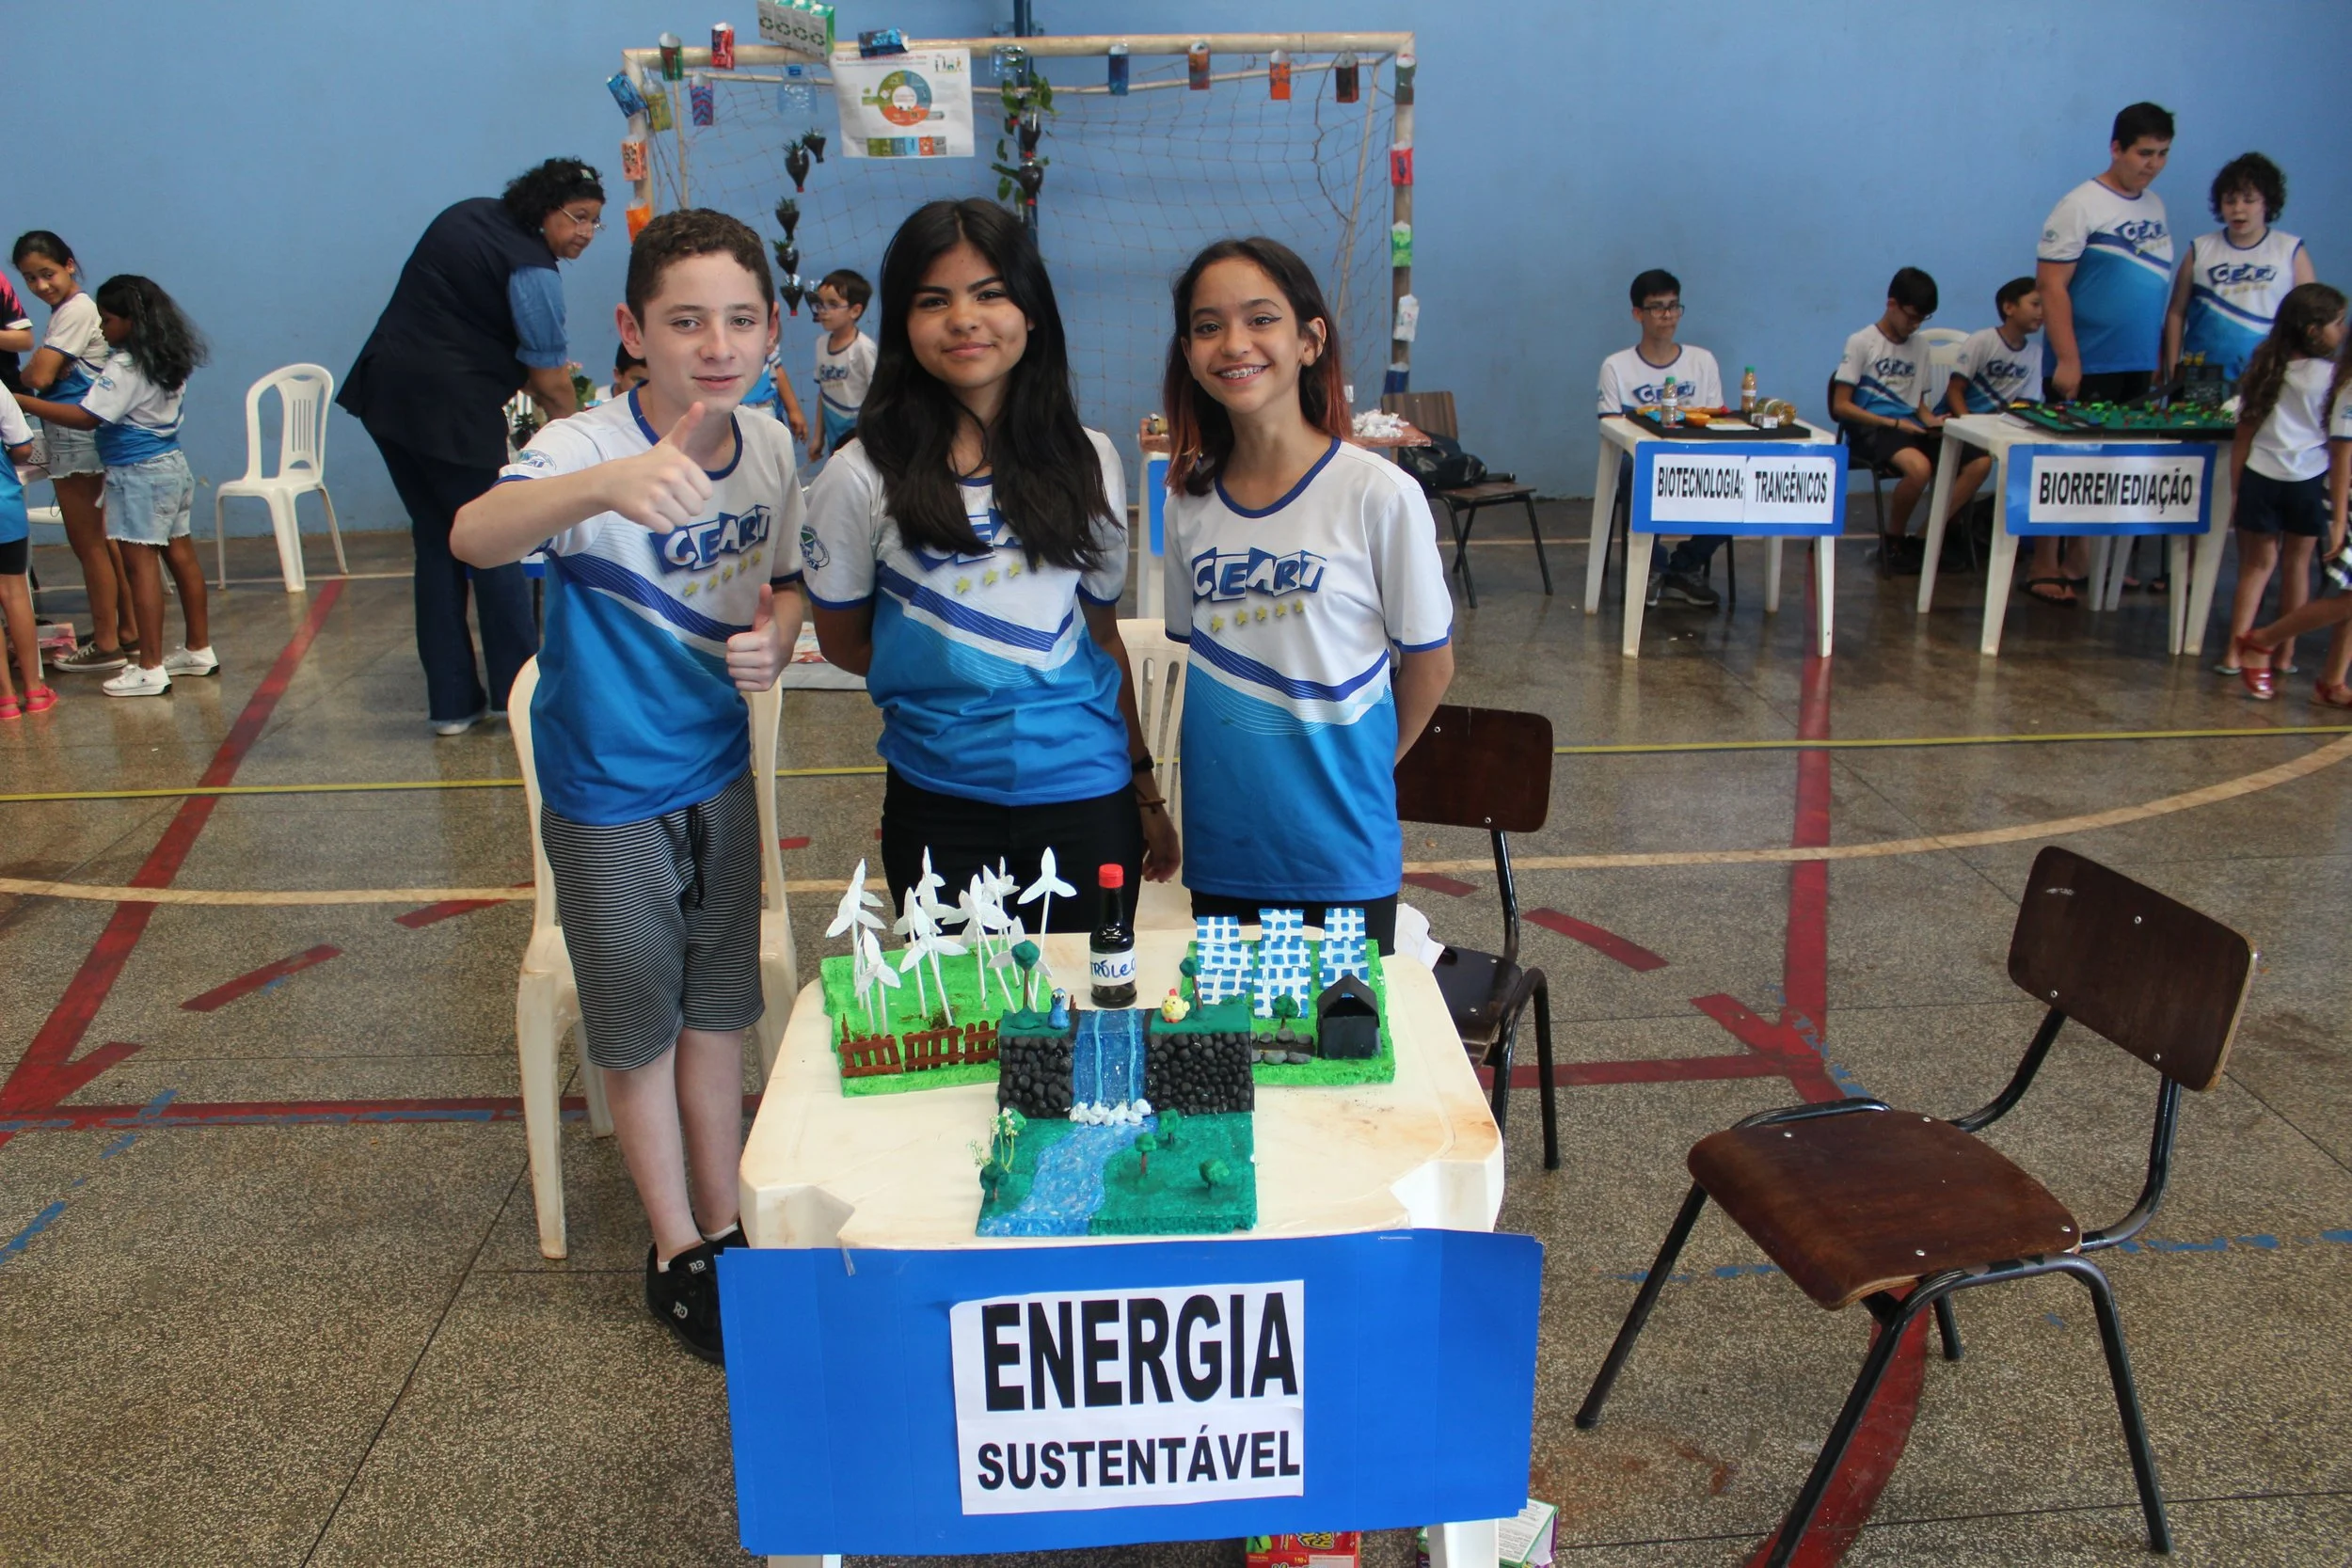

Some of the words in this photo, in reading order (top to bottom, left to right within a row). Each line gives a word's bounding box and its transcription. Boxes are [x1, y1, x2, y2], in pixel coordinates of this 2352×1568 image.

[1658, 467, 1743, 499] BIOTECNOLOGIA:
[2040, 467, 2193, 515] BIORREMEDIAÇÃO
[660, 506, 771, 568] CEART
[1193, 551, 1327, 600] CEART
[981, 1292, 1298, 1412] ENERGIA
[977, 1424, 1300, 1490] SUSTENTÁVEL
